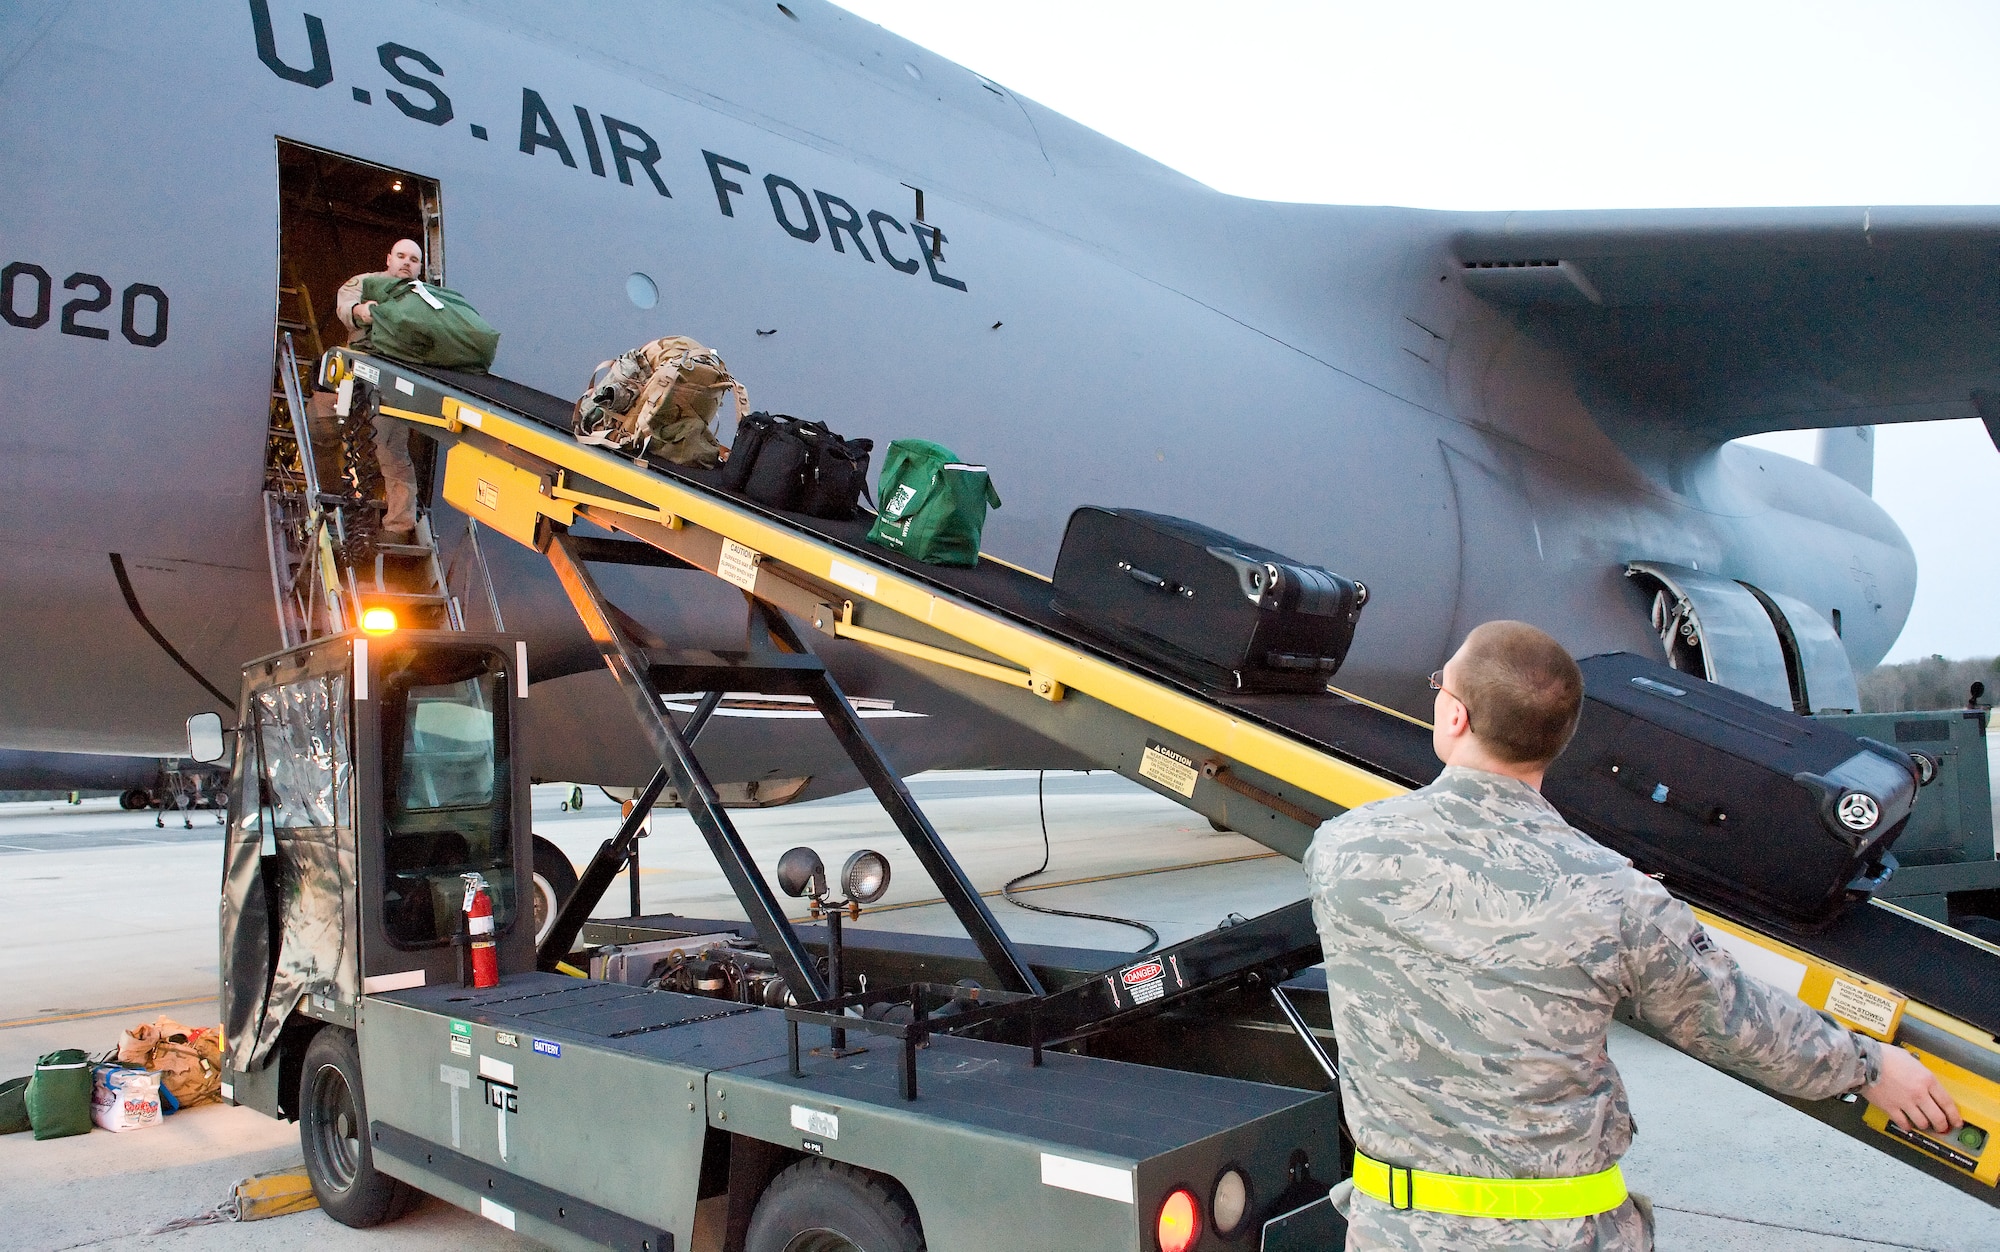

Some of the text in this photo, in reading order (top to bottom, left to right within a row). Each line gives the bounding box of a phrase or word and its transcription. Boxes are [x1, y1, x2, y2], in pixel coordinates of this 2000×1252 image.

[249, 0, 967, 292] U.S. AIR FORCE
[0, 261, 169, 348] 020
[730, 544, 752, 559] CAUTION
[1161, 747, 1192, 767] CAUTION
[1128, 966, 1157, 982] DANGER
[1844, 984, 1856, 992] LOCK
[1863, 992, 1892, 1008] SIDERAIL
[1853, 998, 1866, 1006] POST
[1865, 998, 1883, 1008] INSERT
[1837, 999, 1850, 1008] LOCK
[1857, 1008, 1884, 1022] STOWED
[1846, 1014, 1860, 1022] POST
[1860, 1014, 1877, 1024] INSERT
[534, 1041, 558, 1055] BATTERY
[477, 1075, 518, 1114] TUG
[811, 1143, 821, 1152] PSI
